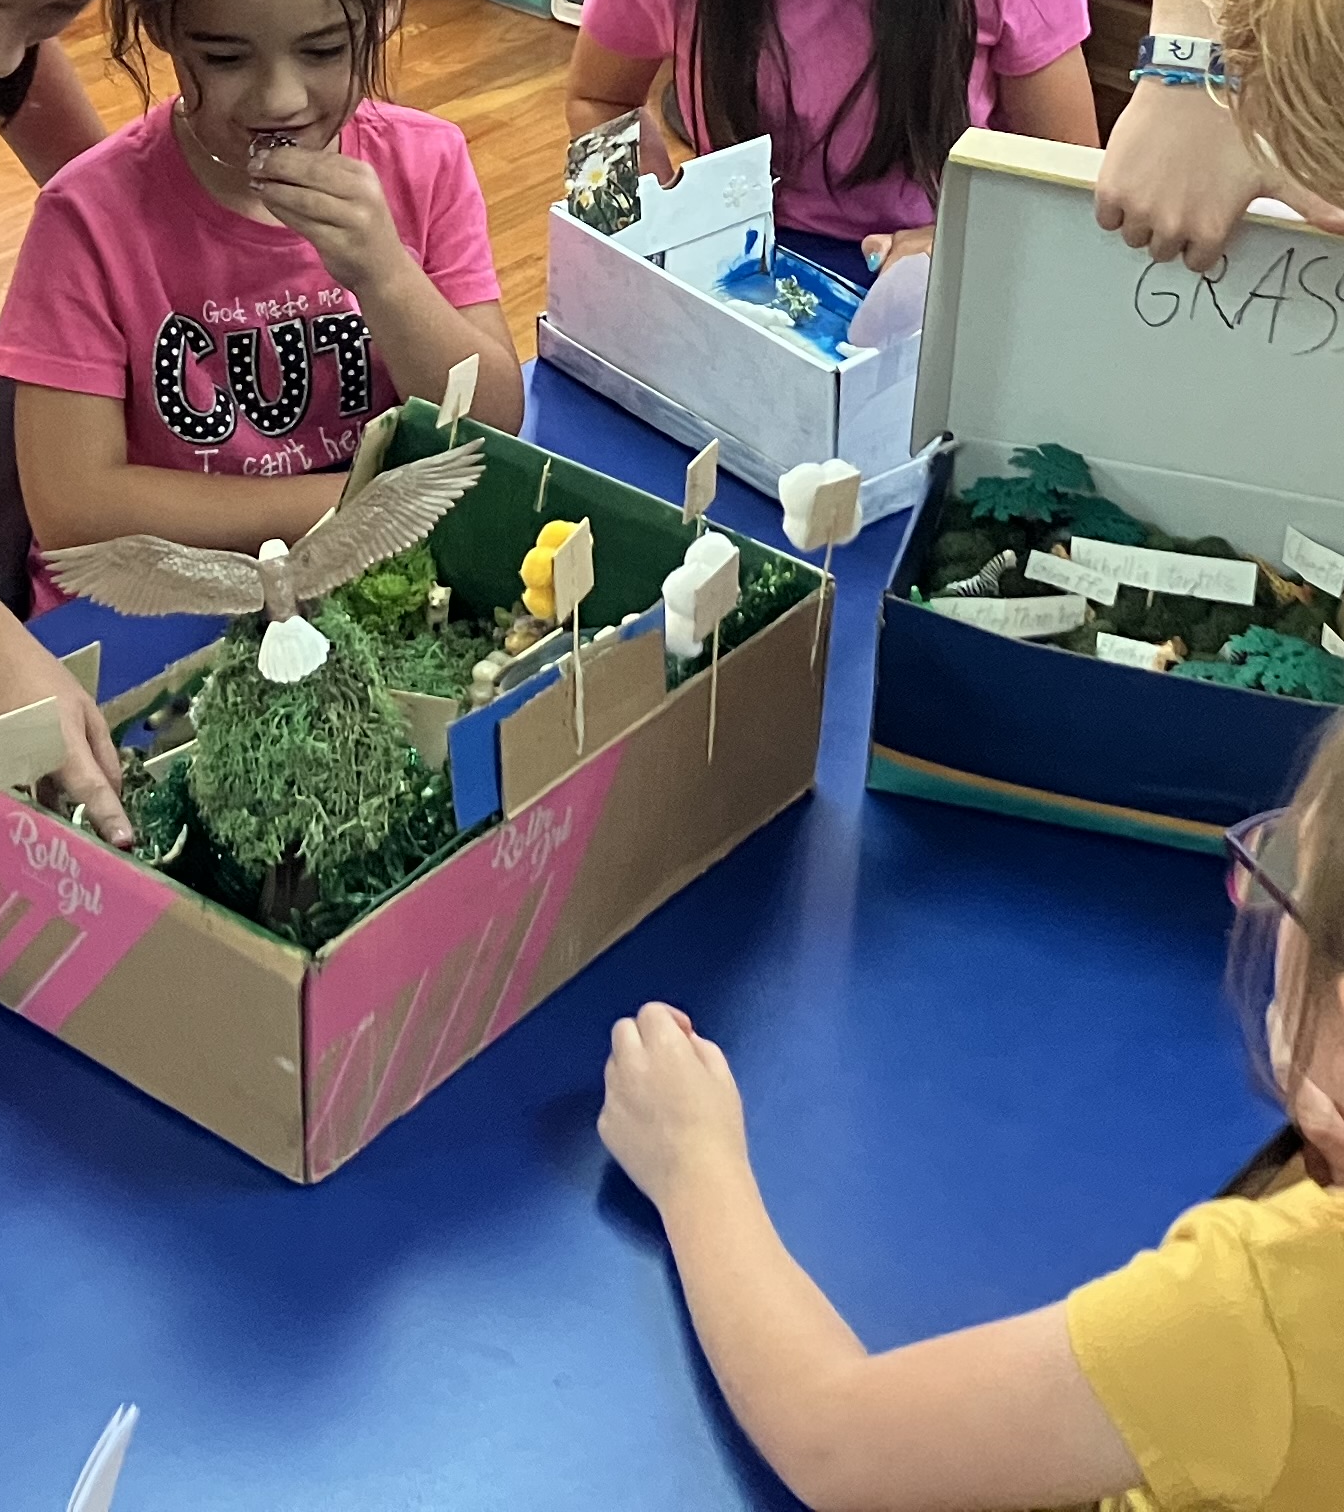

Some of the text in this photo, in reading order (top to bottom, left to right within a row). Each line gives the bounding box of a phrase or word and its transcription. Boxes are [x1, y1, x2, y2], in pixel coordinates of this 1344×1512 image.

[202, 287, 343, 324] God made me
[194, 449, 221, 475] I
[242, 437, 313, 477] can't
